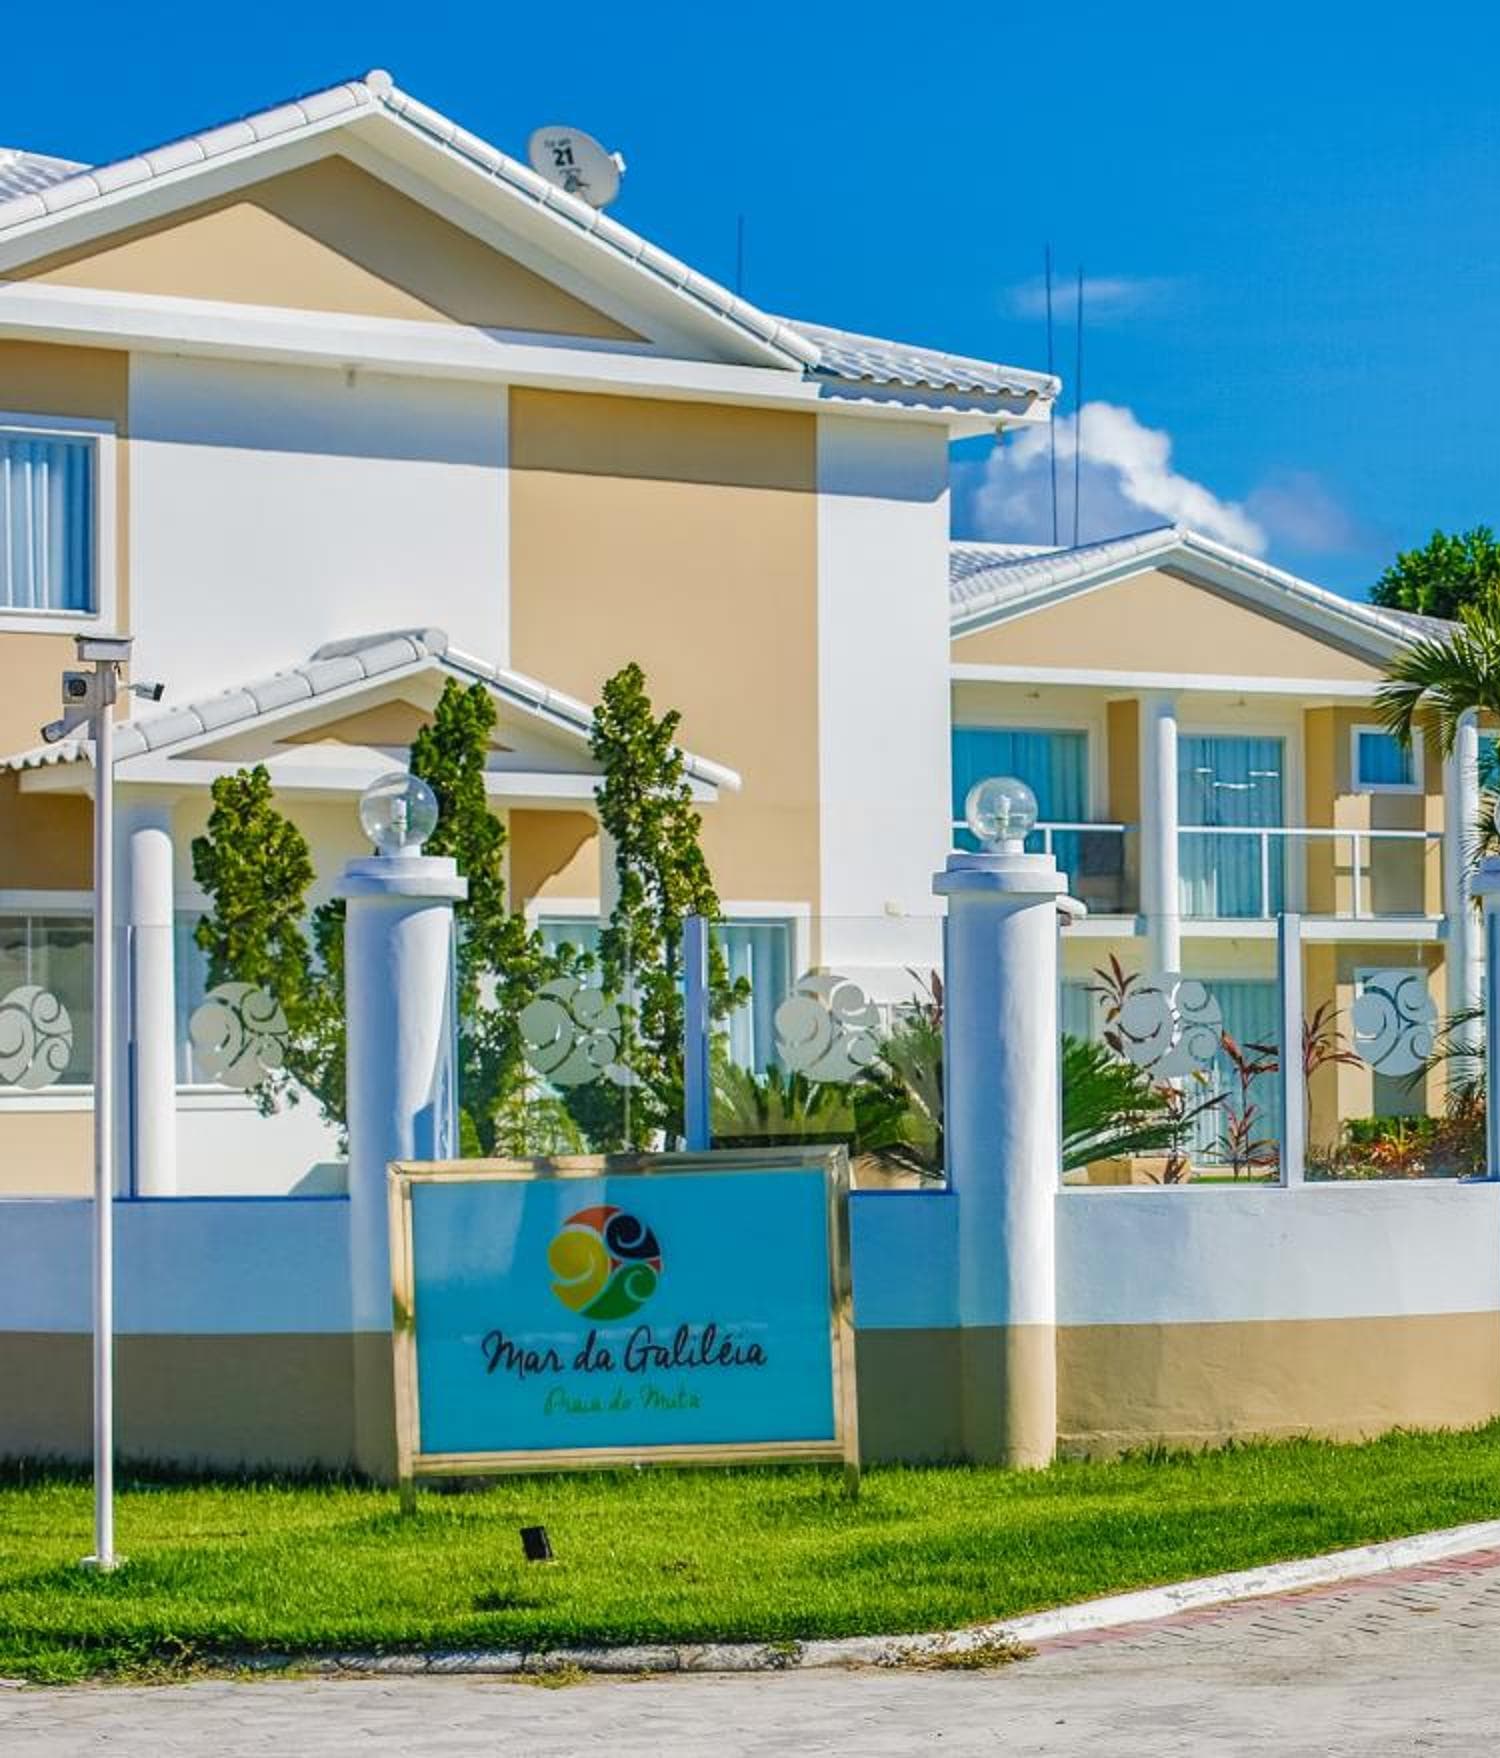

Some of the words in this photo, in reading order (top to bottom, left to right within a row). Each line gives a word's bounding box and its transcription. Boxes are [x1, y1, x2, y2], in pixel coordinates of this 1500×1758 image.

[552, 146, 574, 166] 21
[482, 1329, 563, 1379] Mar
[573, 1329, 615, 1372] da
[624, 1323, 768, 1373] Galiléia
